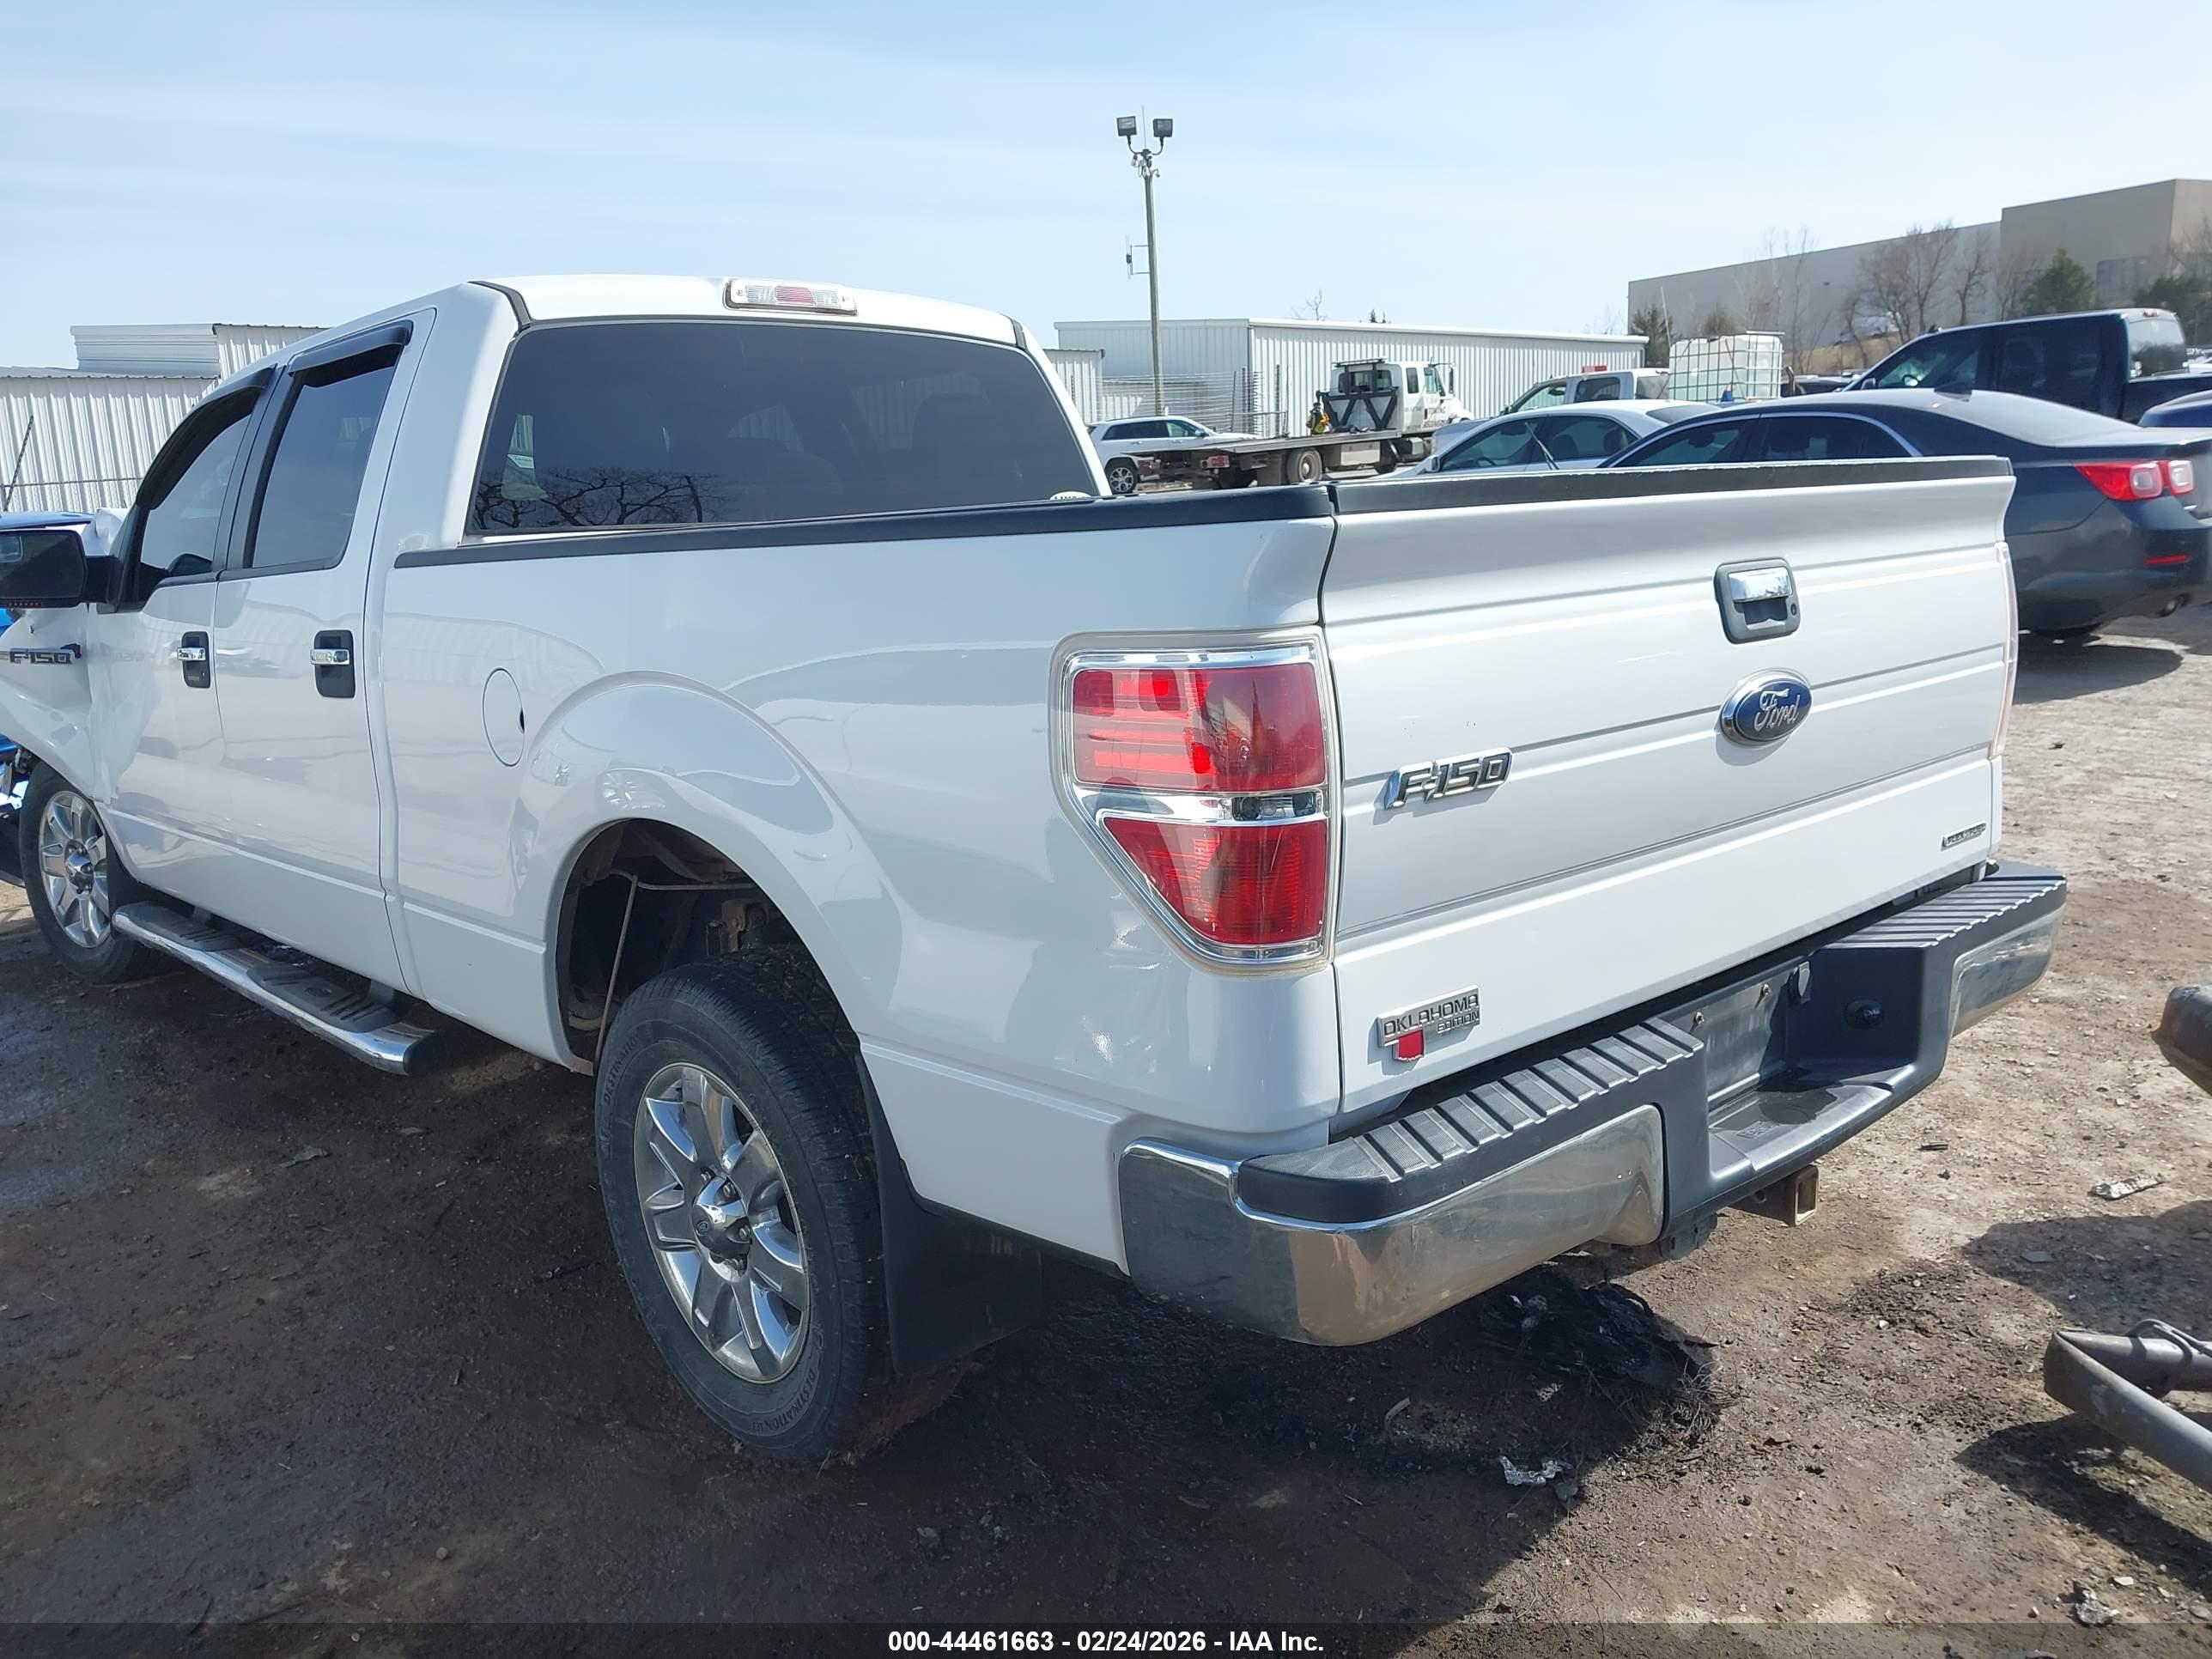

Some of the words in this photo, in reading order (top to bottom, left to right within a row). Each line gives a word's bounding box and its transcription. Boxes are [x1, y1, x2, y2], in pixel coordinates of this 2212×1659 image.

[1753, 687, 1801, 732] Ford
[1387, 747, 1512, 810] F-150
[1382, 993, 1479, 1038] OKLAHOMA
[1436, 1011, 1480, 1035] EDITION
